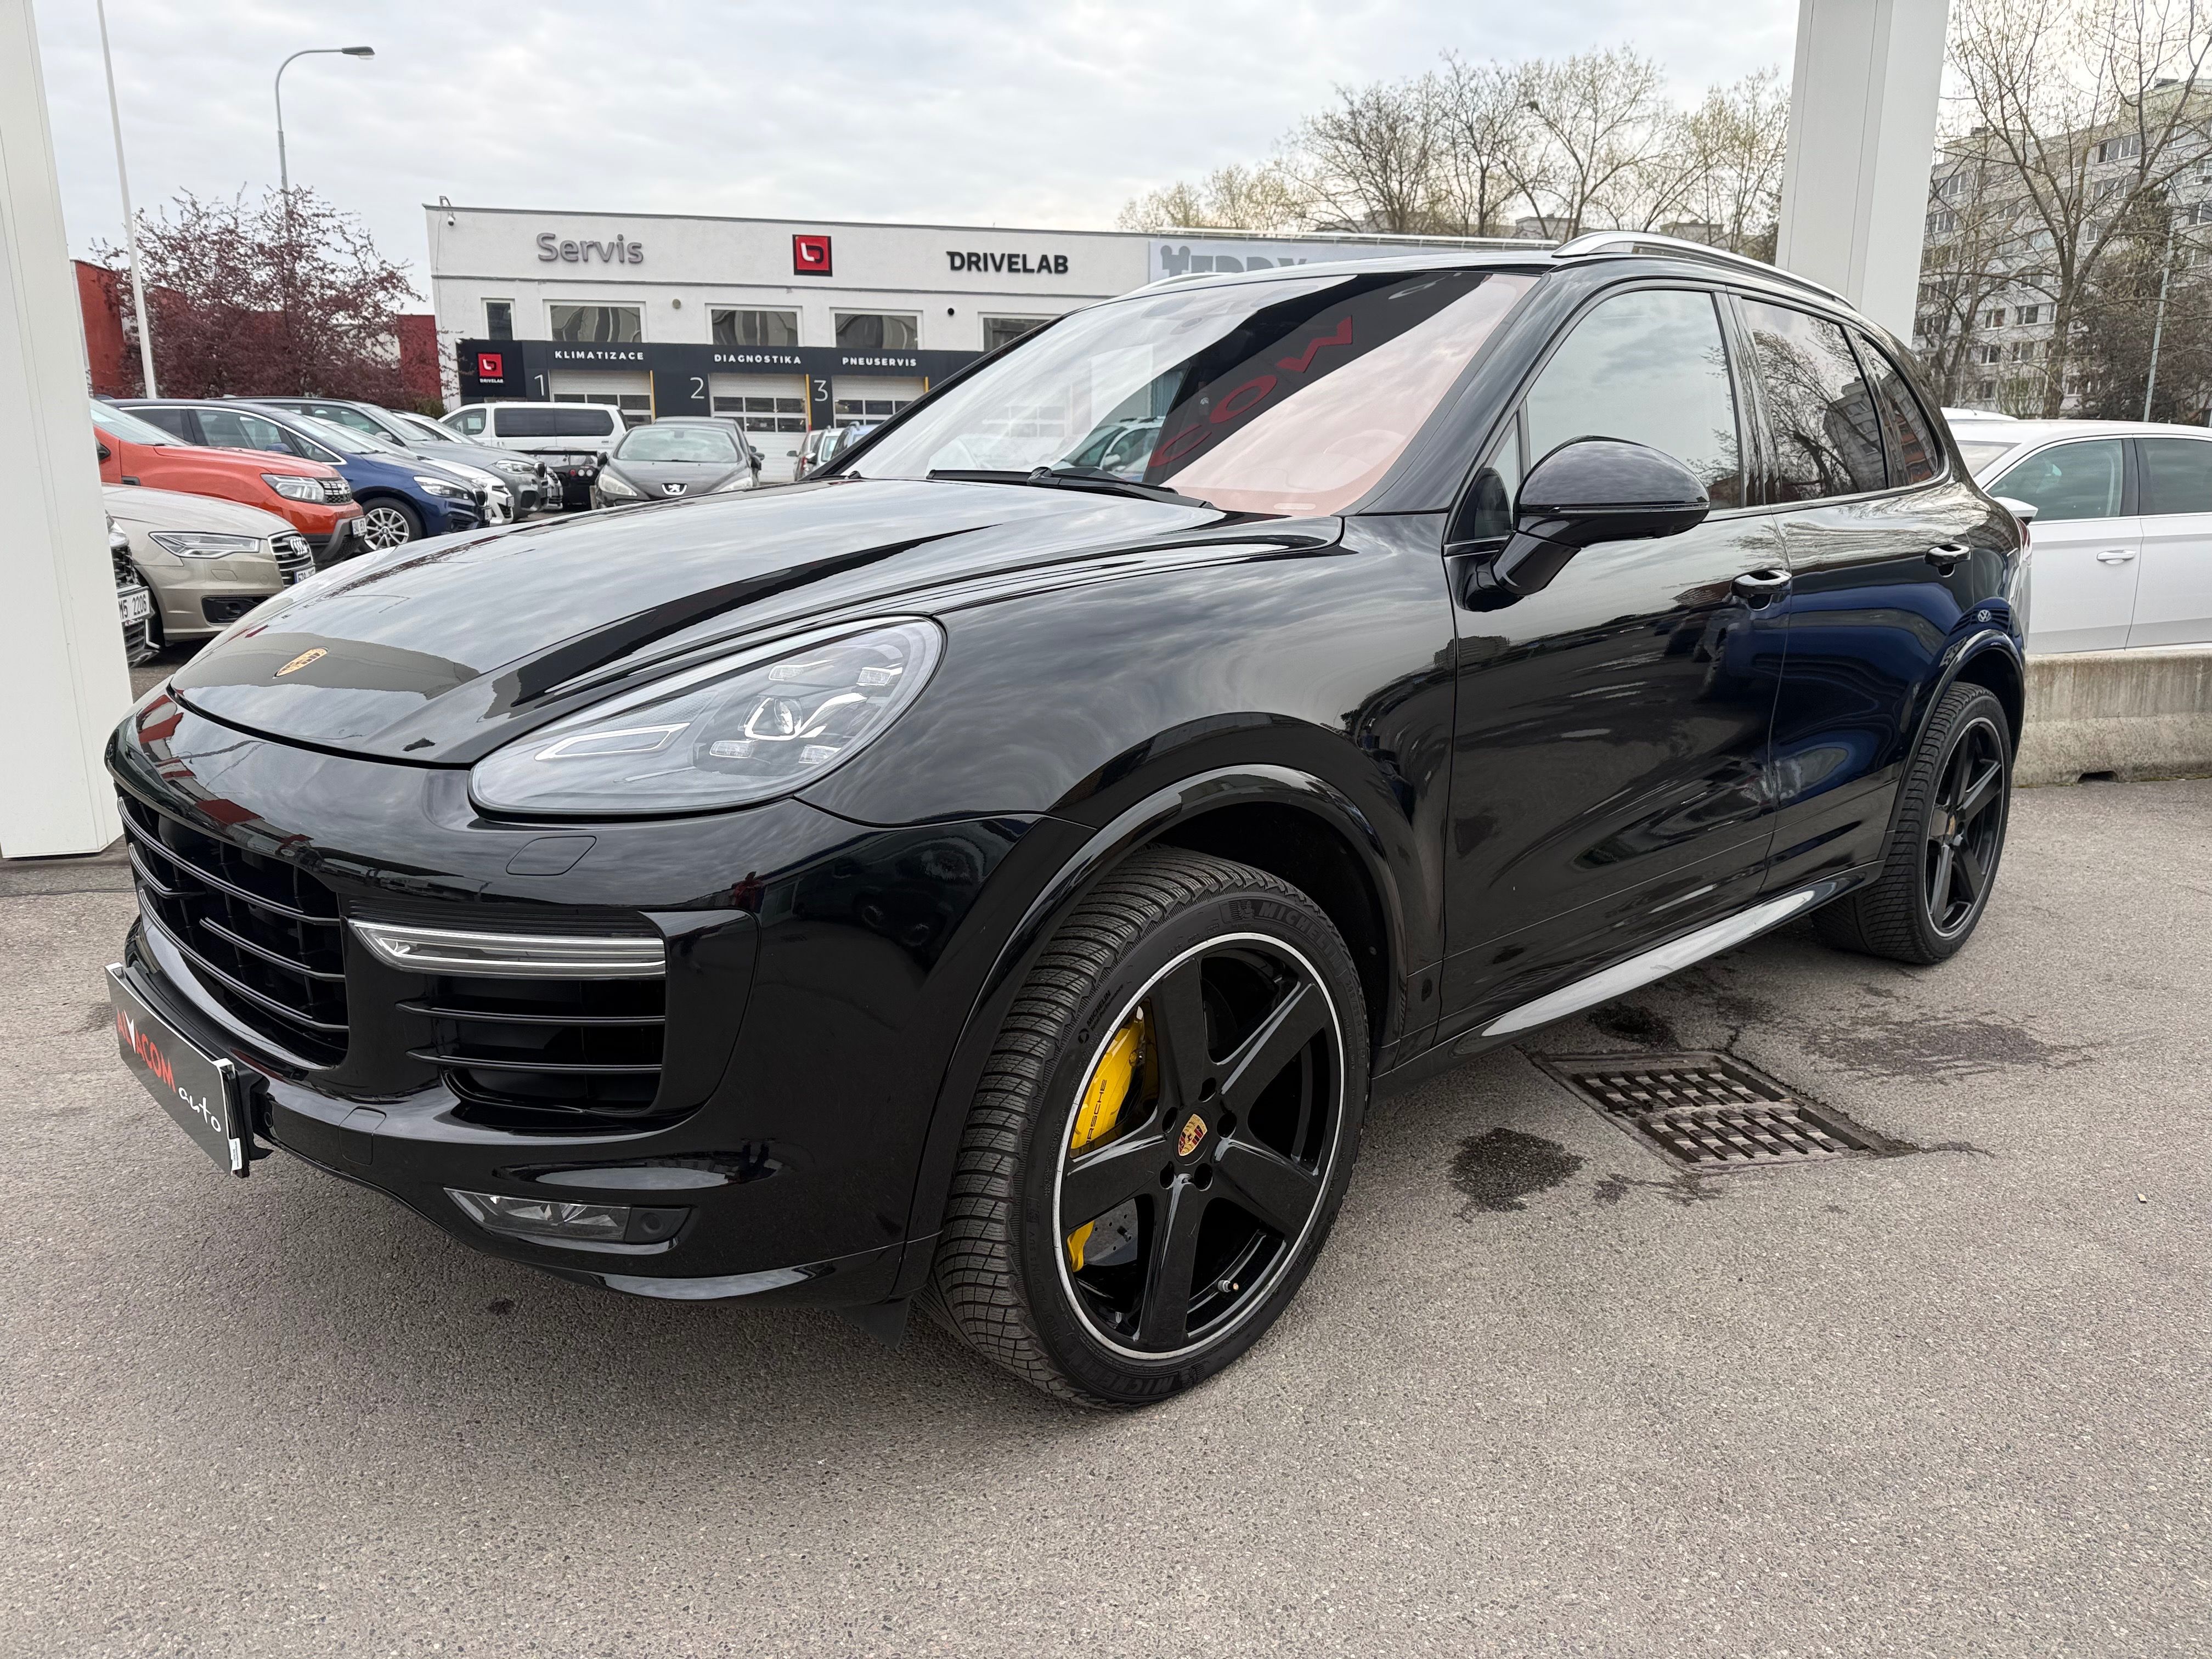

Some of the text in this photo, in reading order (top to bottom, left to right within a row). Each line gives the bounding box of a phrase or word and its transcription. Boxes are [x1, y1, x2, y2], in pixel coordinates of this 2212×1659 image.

[536, 232, 644, 264] Servis
[946, 251, 1069, 274] DRIVELAB
[555, 350, 645, 361] KLIMATIZACE
[714, 353, 802, 365] DIAGNOSTIKA
[842, 357, 917, 367] PNEUSERVIS
[534, 374, 545, 396] 1
[690, 377, 706, 399] 2
[814, 380, 829, 402] 3
[118, 594, 147, 620] M5 2206
[1259, 901, 1344, 972] MICHELIN
[1087, 990, 1111, 1027] MICHELIN
[178, 1087, 222, 1132] auto
[1086, 1079, 1108, 1144] RSCHE
